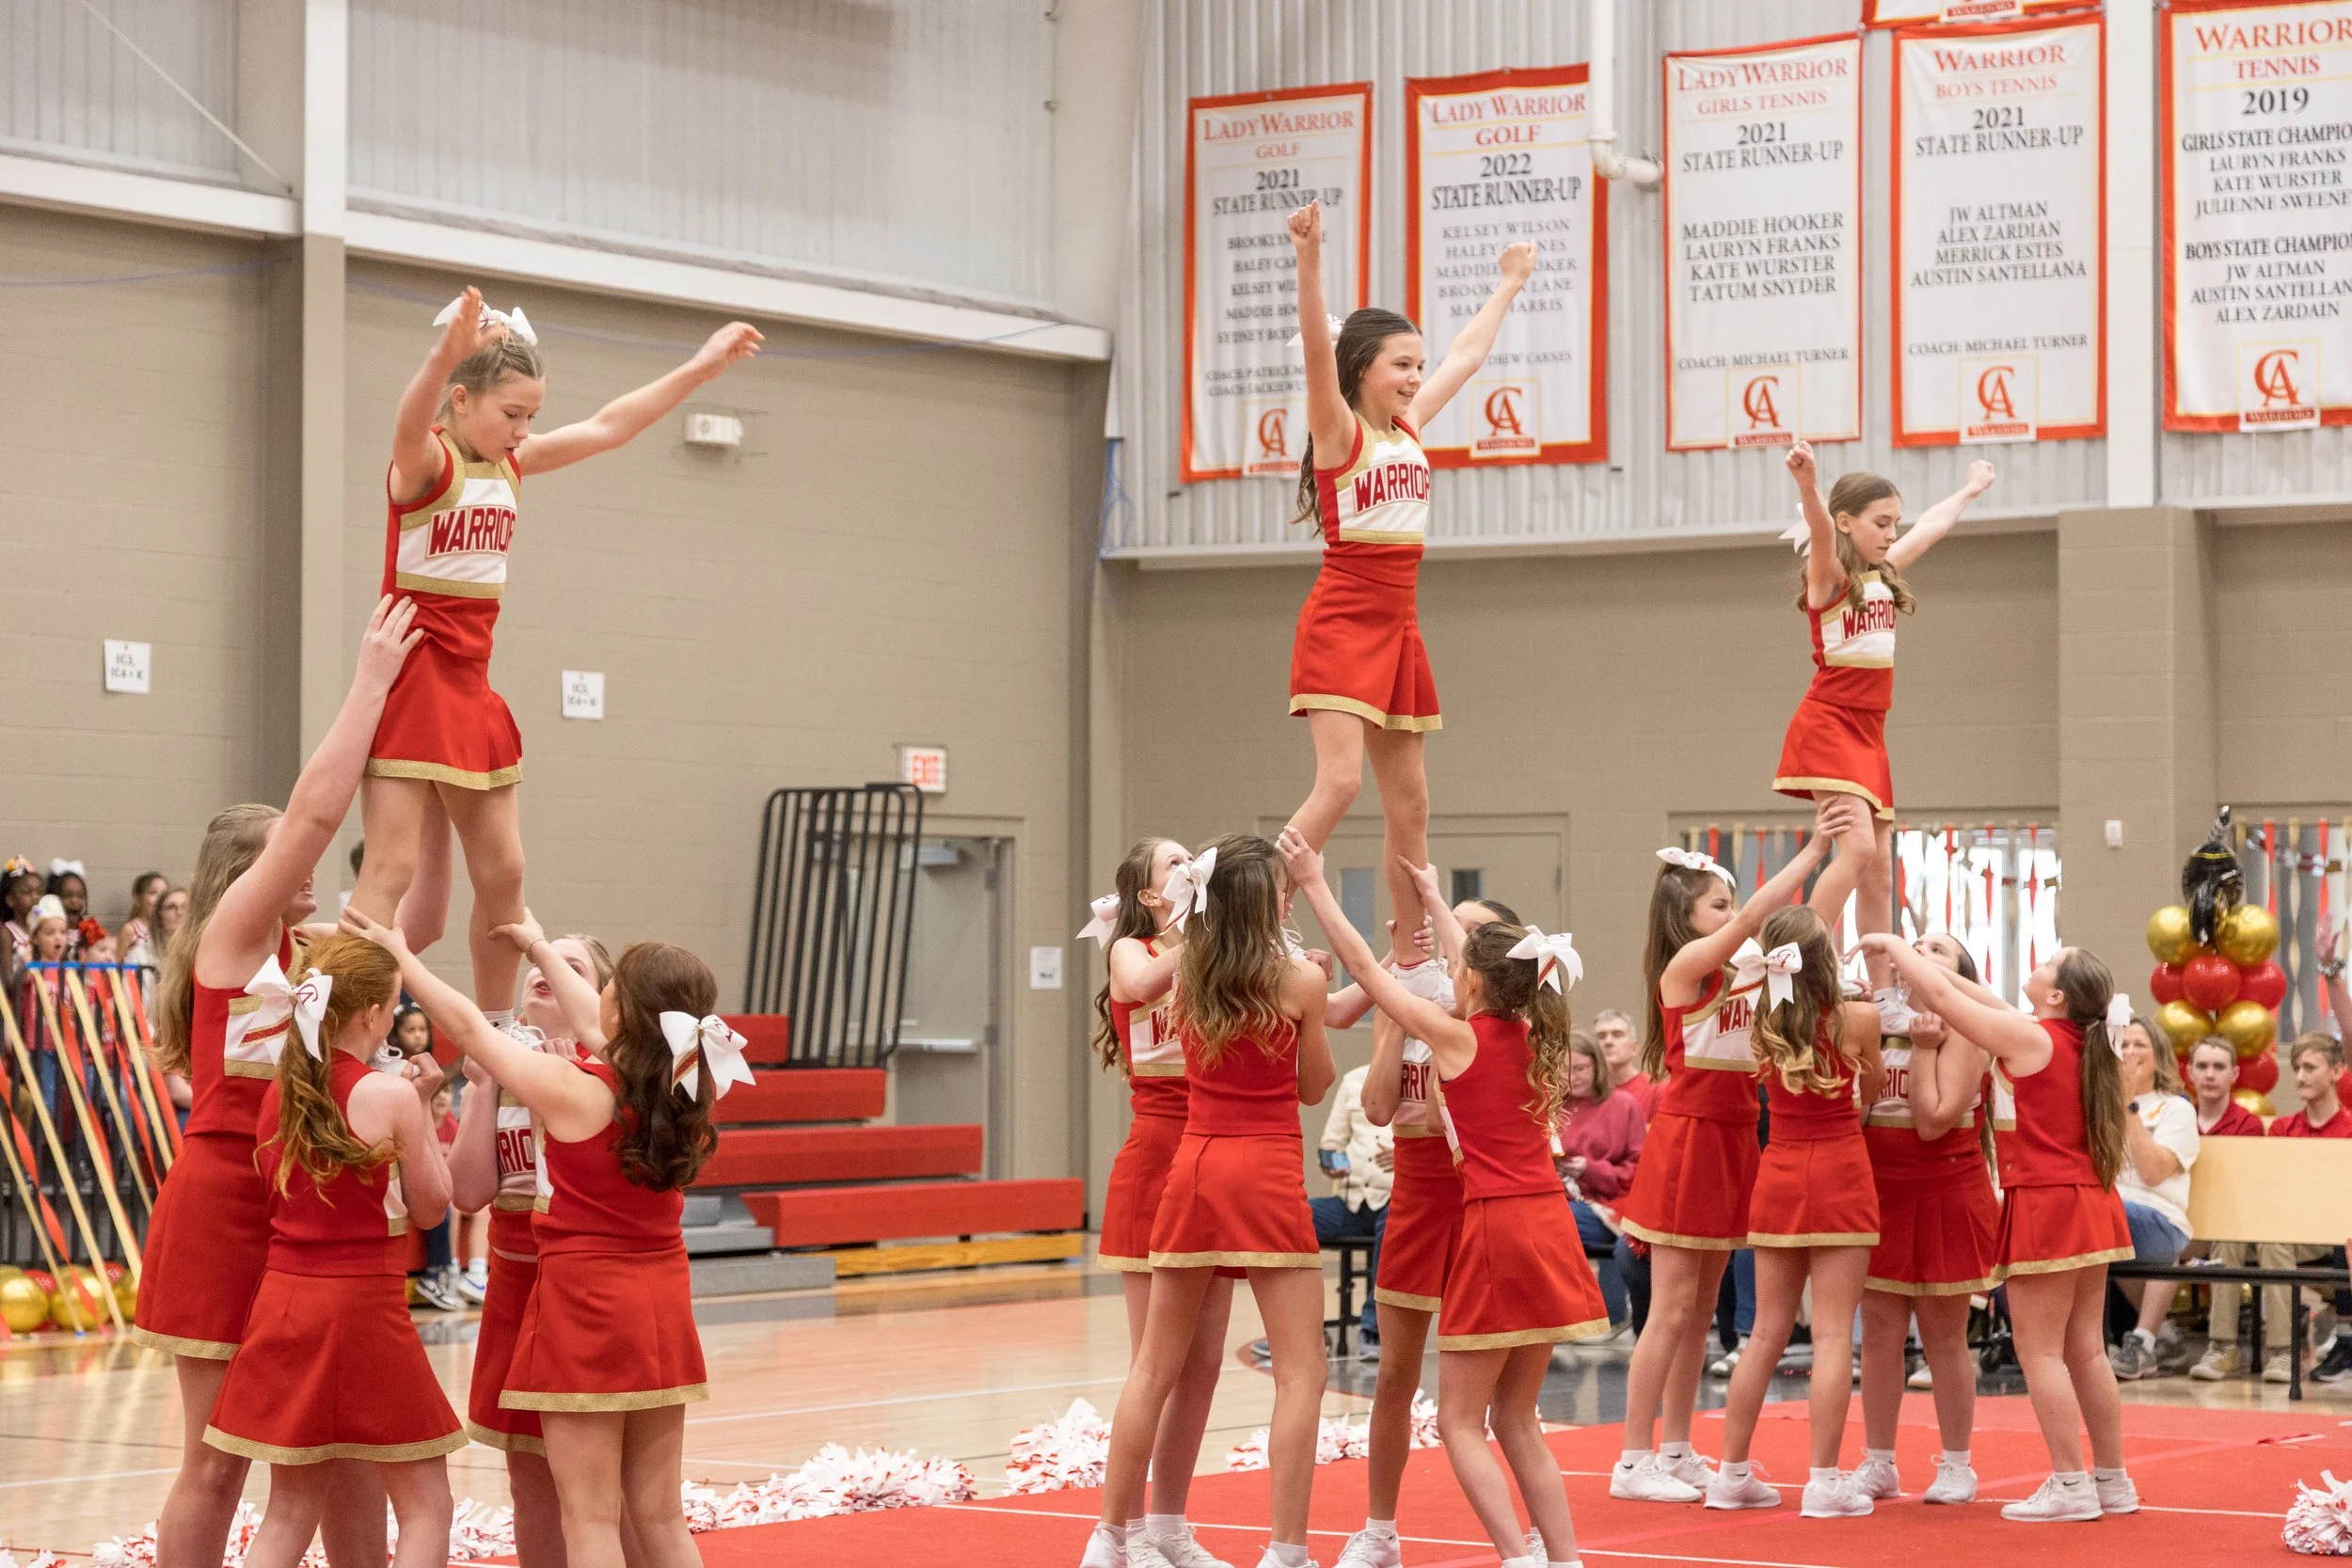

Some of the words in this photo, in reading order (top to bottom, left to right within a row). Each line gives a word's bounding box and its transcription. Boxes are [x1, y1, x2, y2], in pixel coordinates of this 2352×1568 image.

[2195, 17, 2352, 52] WARRIOR
[1932, 44, 2067, 72] WARRIOR
[2235, 55, 2320, 79] TENNIS
[1677, 68, 1740, 91] LADY
[1741, 57, 1848, 86] WARRIOR
[1935, 81, 1984, 99] BOYS
[1990, 74, 2058, 94] TENNIS
[1432, 101, 1486, 123] LADY
[1490, 93, 1586, 117] WARRIOR
[1697, 96, 1753, 115] GIRLS
[1758, 89, 1828, 111] TENNIS
[2241, 87, 2310, 117] 2019
[1204, 119, 1258, 140] LADY
[1260, 110, 1354, 134] WARRIOR
[1972, 105, 2025, 129] 2021
[1475, 124, 1541, 146] GOLF
[1737, 120, 1788, 145] 2021
[1915, 134, 1972, 157] STATE
[1975, 124, 2084, 152] RUNNER-UP
[2182, 133, 2224, 151] GIRLS
[2228, 128, 2274, 149] STATE
[1255, 142, 1301, 158] GOLF
[1682, 149, 1736, 173] STATE
[1740, 139, 1844, 168] RUNNER-UP
[2210, 151, 2275, 172] LAURYN
[2279, 147, 2346, 166] FRANKS
[1480, 152, 1532, 178] 2022
[1256, 168, 1299, 190] 2021
[2214, 174, 2253, 193] KATE
[2258, 169, 2343, 189] WURSTER
[1213, 194, 1257, 215] STATE
[1259, 187, 1343, 211] RUNNER-UP
[1431, 182, 1482, 210] STATE
[1485, 176, 1581, 205] RUNNER-UP
[2195, 196, 2275, 220] JULIENNE
[2280, 189, 2352, 208] SWEENE
[1682, 218, 1758, 240] MADDIE
[1763, 211, 1844, 234] HOOKER
[1949, 205, 1972, 226] JW
[1976, 200, 2049, 223] ALTMAN
[1442, 221, 1502, 239] KELSEY
[1505, 217, 1570, 234] WILSON
[1937, 227, 1979, 245] ALEX
[1983, 220, 2061, 242] ZARDIAN
[1445, 243, 1498, 259] HALEY
[1685, 238, 1762, 260] LAURYN
[1767, 232, 1842, 253] FRANKS
[1935, 245, 2010, 264] MERRICK
[2015, 241, 2064, 259] ESTES
[2185, 242, 2222, 260] BOYS
[2224, 237, 2270, 257] STATE
[2275, 232, 2352, 255] CHAMPIO
[1534, 258, 1577, 274] OKER
[1691, 261, 1740, 281] KATE
[1745, 254, 1836, 277] WURSTER
[1911, 267, 1974, 288] AUSTIN
[1978, 260, 2087, 282] SANTELLANA
[2227, 263, 2250, 281] JW
[2256, 259, 2326, 278] ALTMAN
[1532, 278, 1573, 293] LANE
[1690, 282, 1757, 302] TATUM
[1762, 276, 1837, 297] SNYDER
[2190, 285, 2250, 304] AUSTIN
[1450, 303, 1485, 318] MAR
[2215, 308, 2257, 324] ALEX
[2262, 301, 2341, 321] ZARDAIN
[1527, 350, 1572, 363] CARNES
[1965, 337, 2029, 354] MICHAEL
[2033, 334, 2089, 350] TURNER
[1732, 350, 1791, 367] MICHAEL
[1795, 347, 1850, 362] TURNER
[1841, 599, 1896, 641] WARRIO
